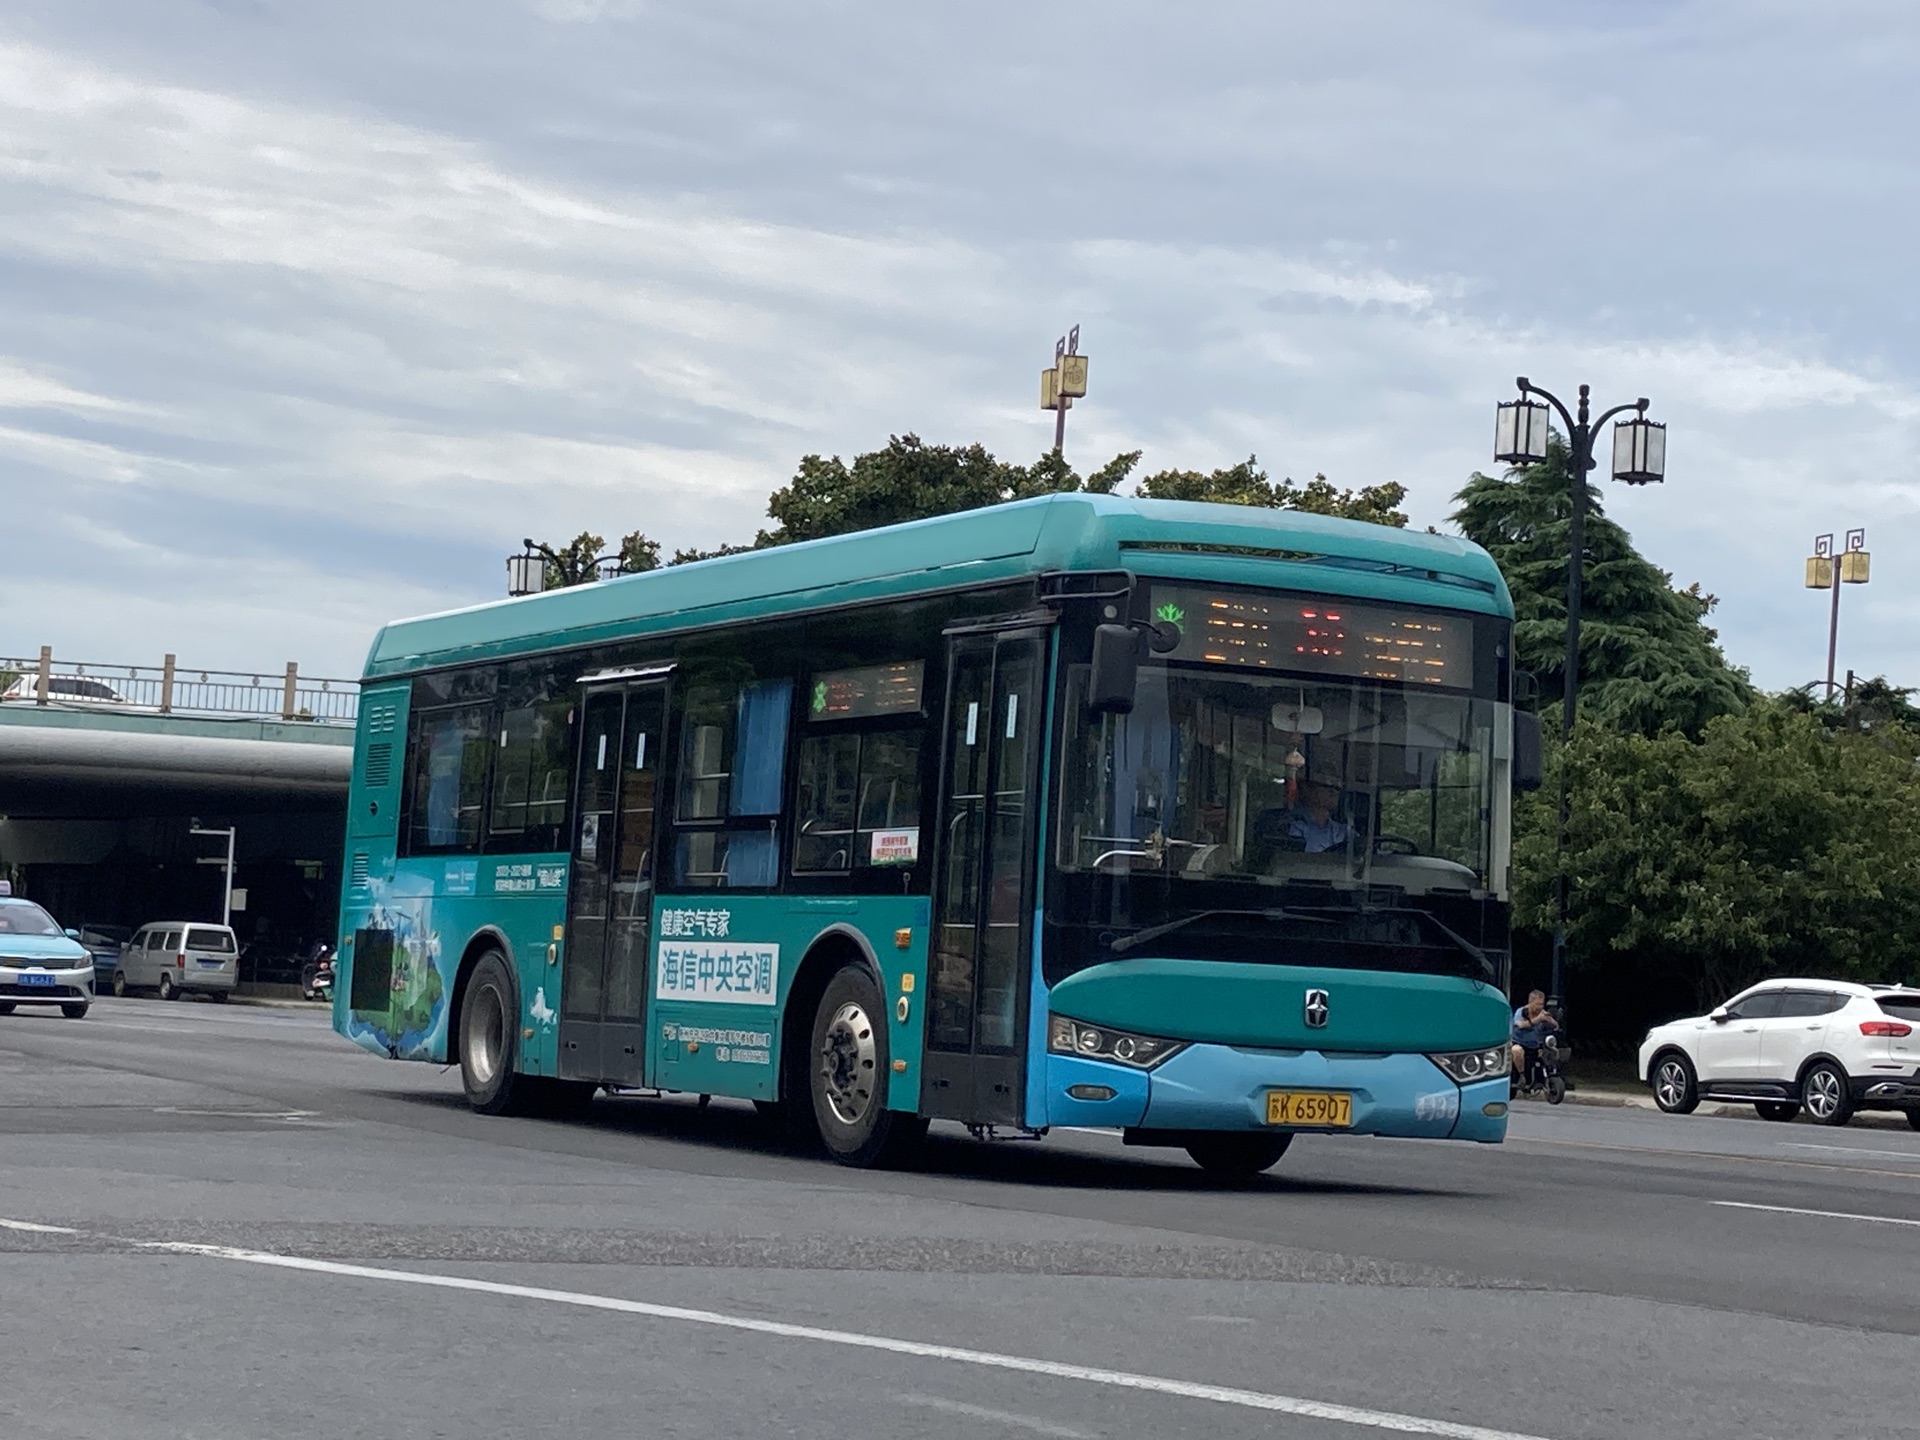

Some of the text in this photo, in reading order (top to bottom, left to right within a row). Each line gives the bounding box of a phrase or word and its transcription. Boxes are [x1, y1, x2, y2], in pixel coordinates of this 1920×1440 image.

[660, 908, 731, 938] 健康空气专家
[660, 948, 773, 995] 海信中央空调
